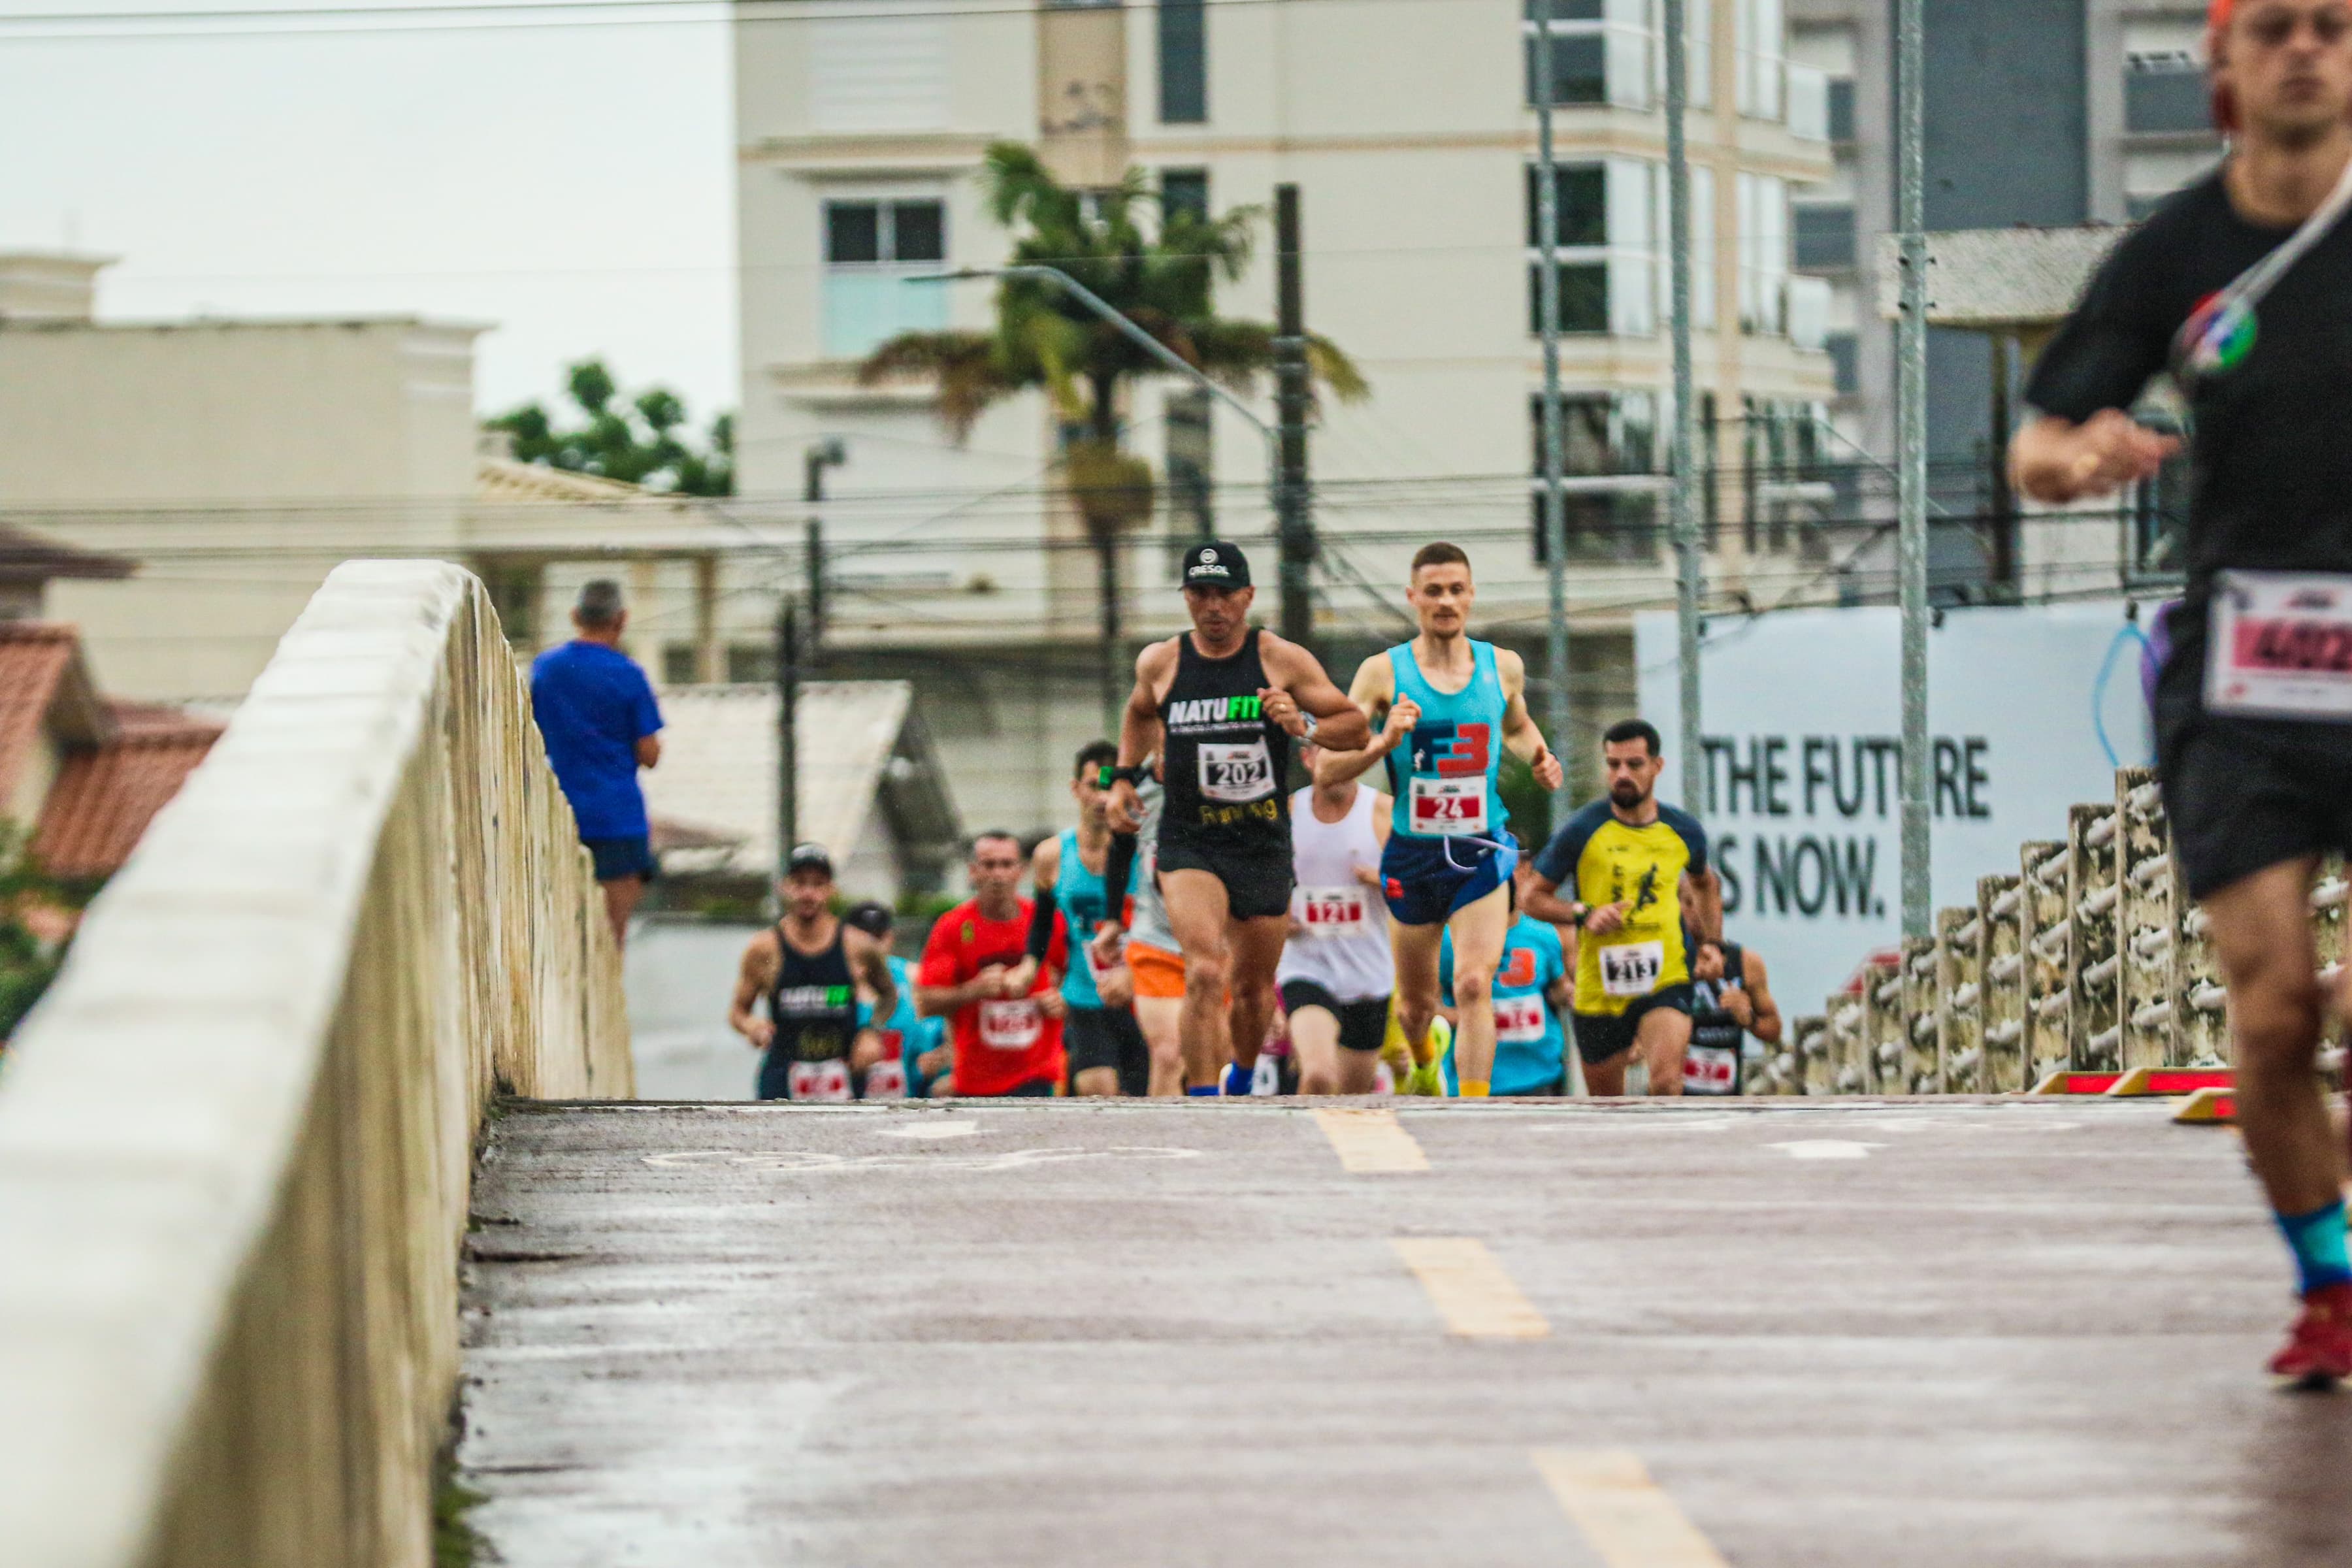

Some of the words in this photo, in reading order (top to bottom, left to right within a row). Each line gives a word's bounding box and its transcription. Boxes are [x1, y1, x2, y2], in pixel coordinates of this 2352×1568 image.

[1168, 695, 1264, 725] NATUFIT
[1411, 719, 1490, 778] F3
[1216, 762, 1261, 785] 202
[1701, 736, 1789, 816] THE
[1803, 736, 1990, 817] FUTRE
[1434, 796, 1463, 817] 24
[1709, 834, 1741, 913] S
[1756, 836, 1884, 916] NOW.
